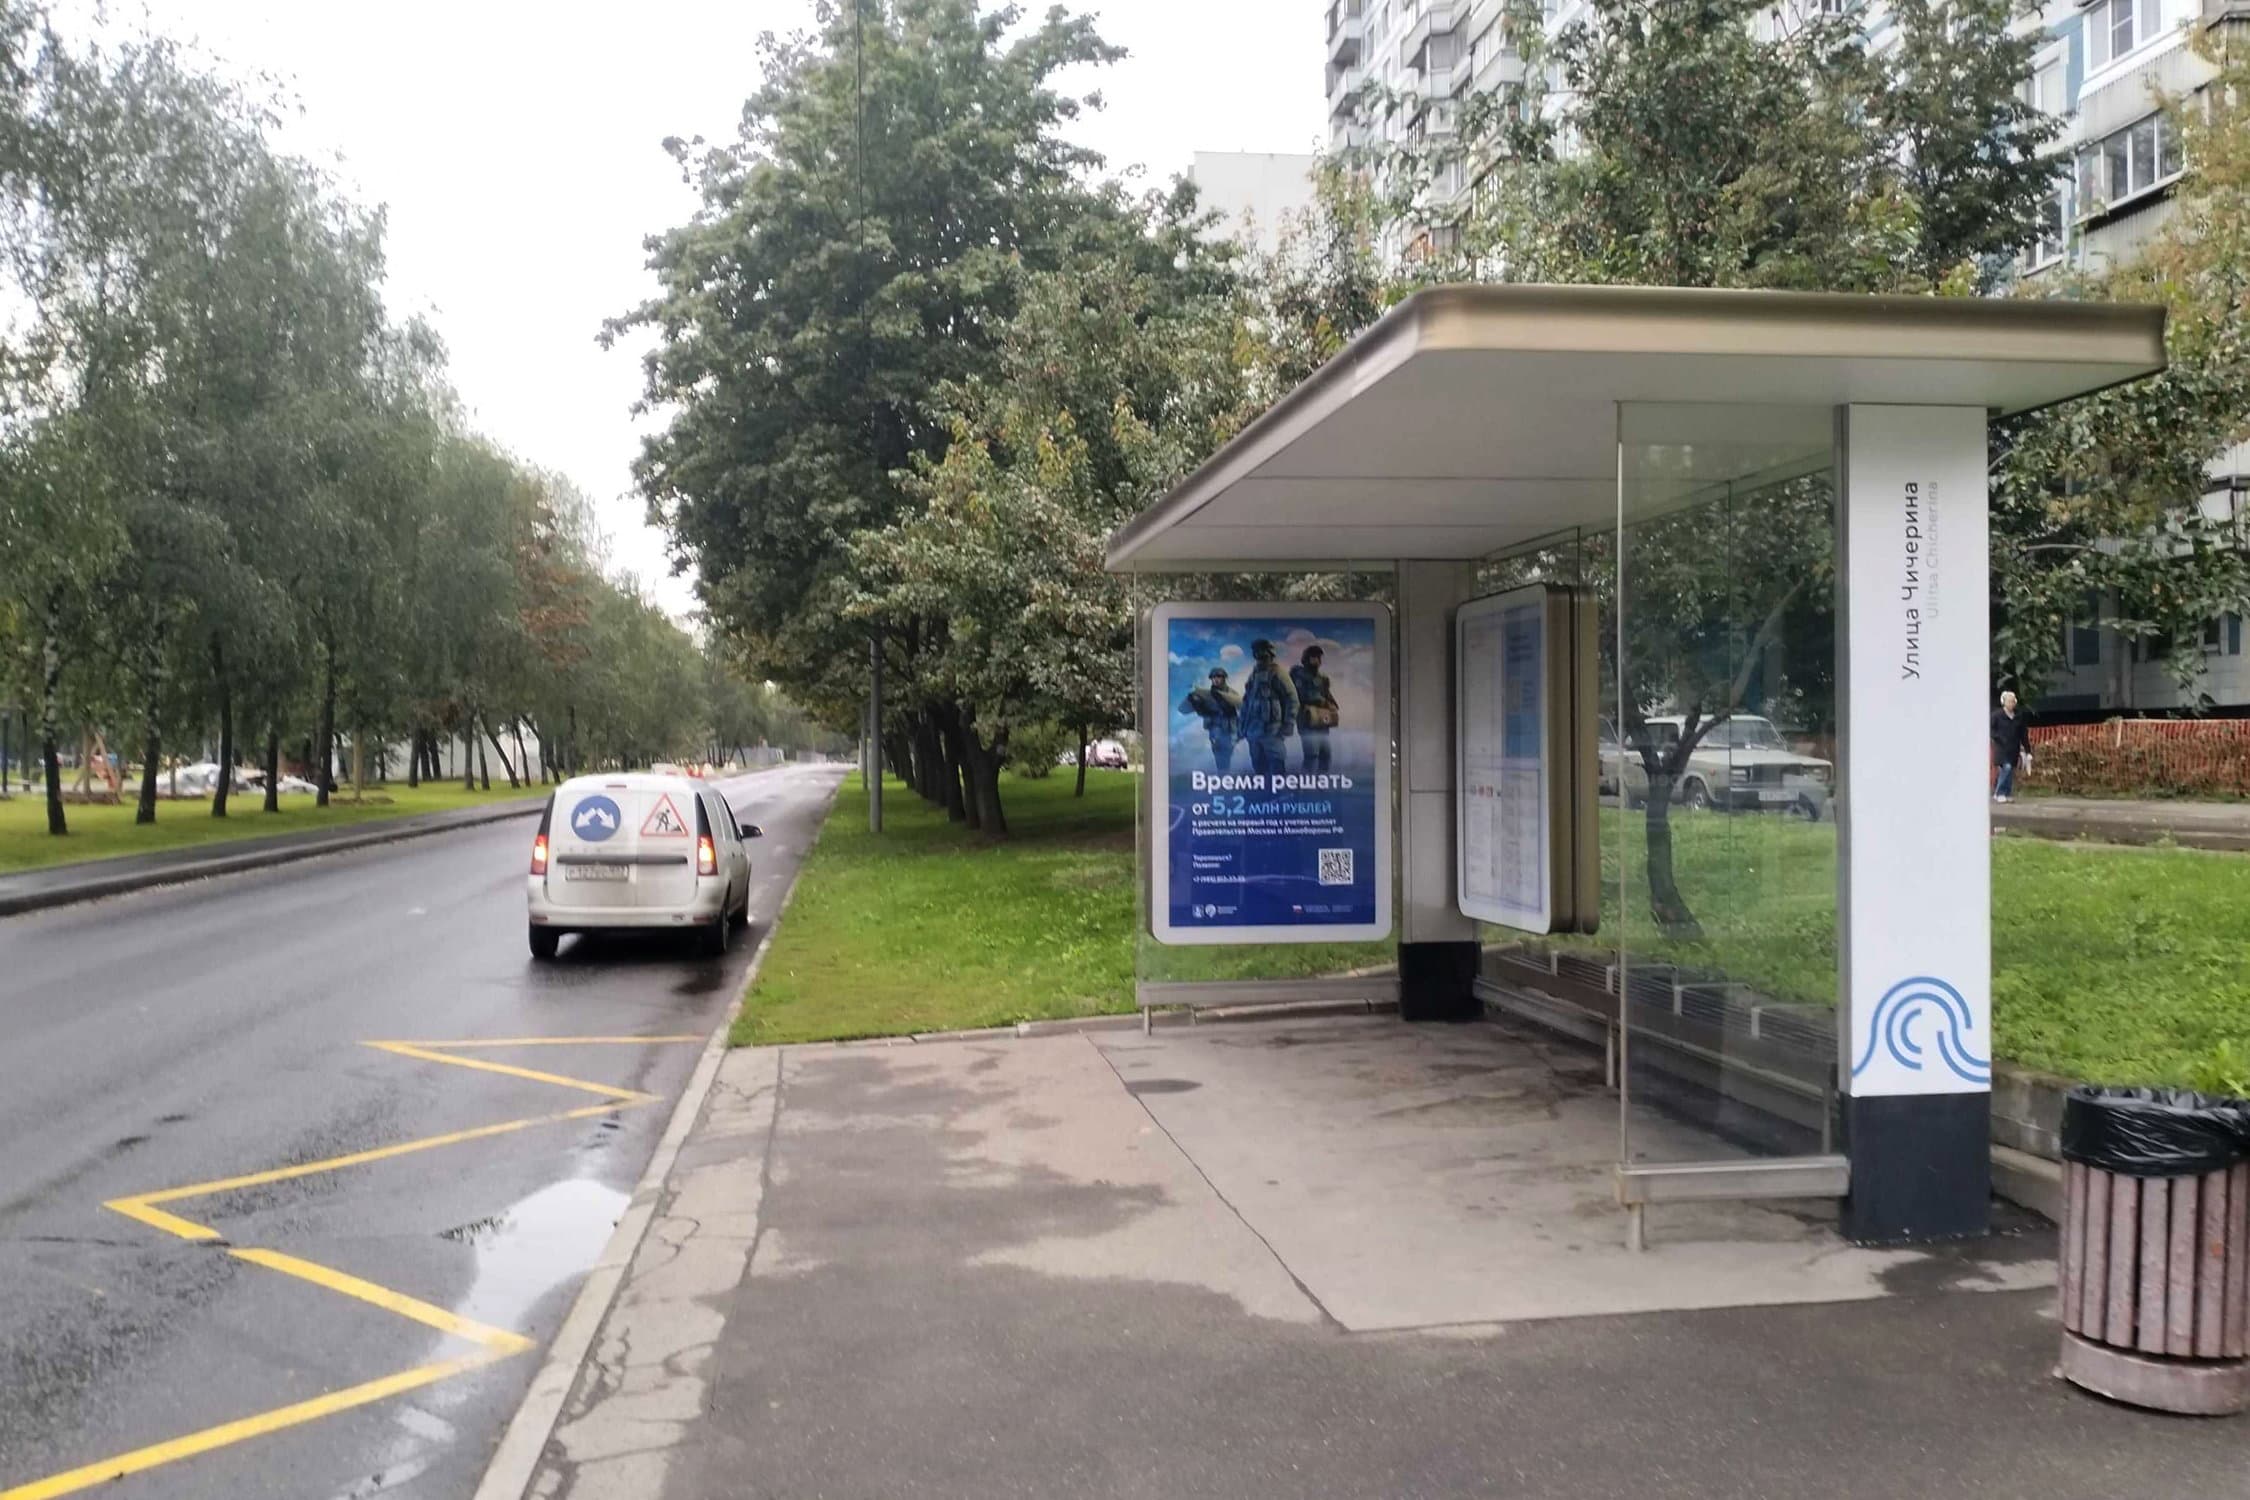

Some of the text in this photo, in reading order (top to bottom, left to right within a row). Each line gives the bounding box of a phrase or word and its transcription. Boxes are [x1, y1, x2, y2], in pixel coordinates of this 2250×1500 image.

[1902, 482, 1922, 680] Улица Чичерина
[1926, 481, 1939, 619] Ulitsa Chicherina
[1191, 770, 1353, 794] Время решать
[1191, 803, 1210, 816] от
[1212, 795, 1245, 817] 5,2
